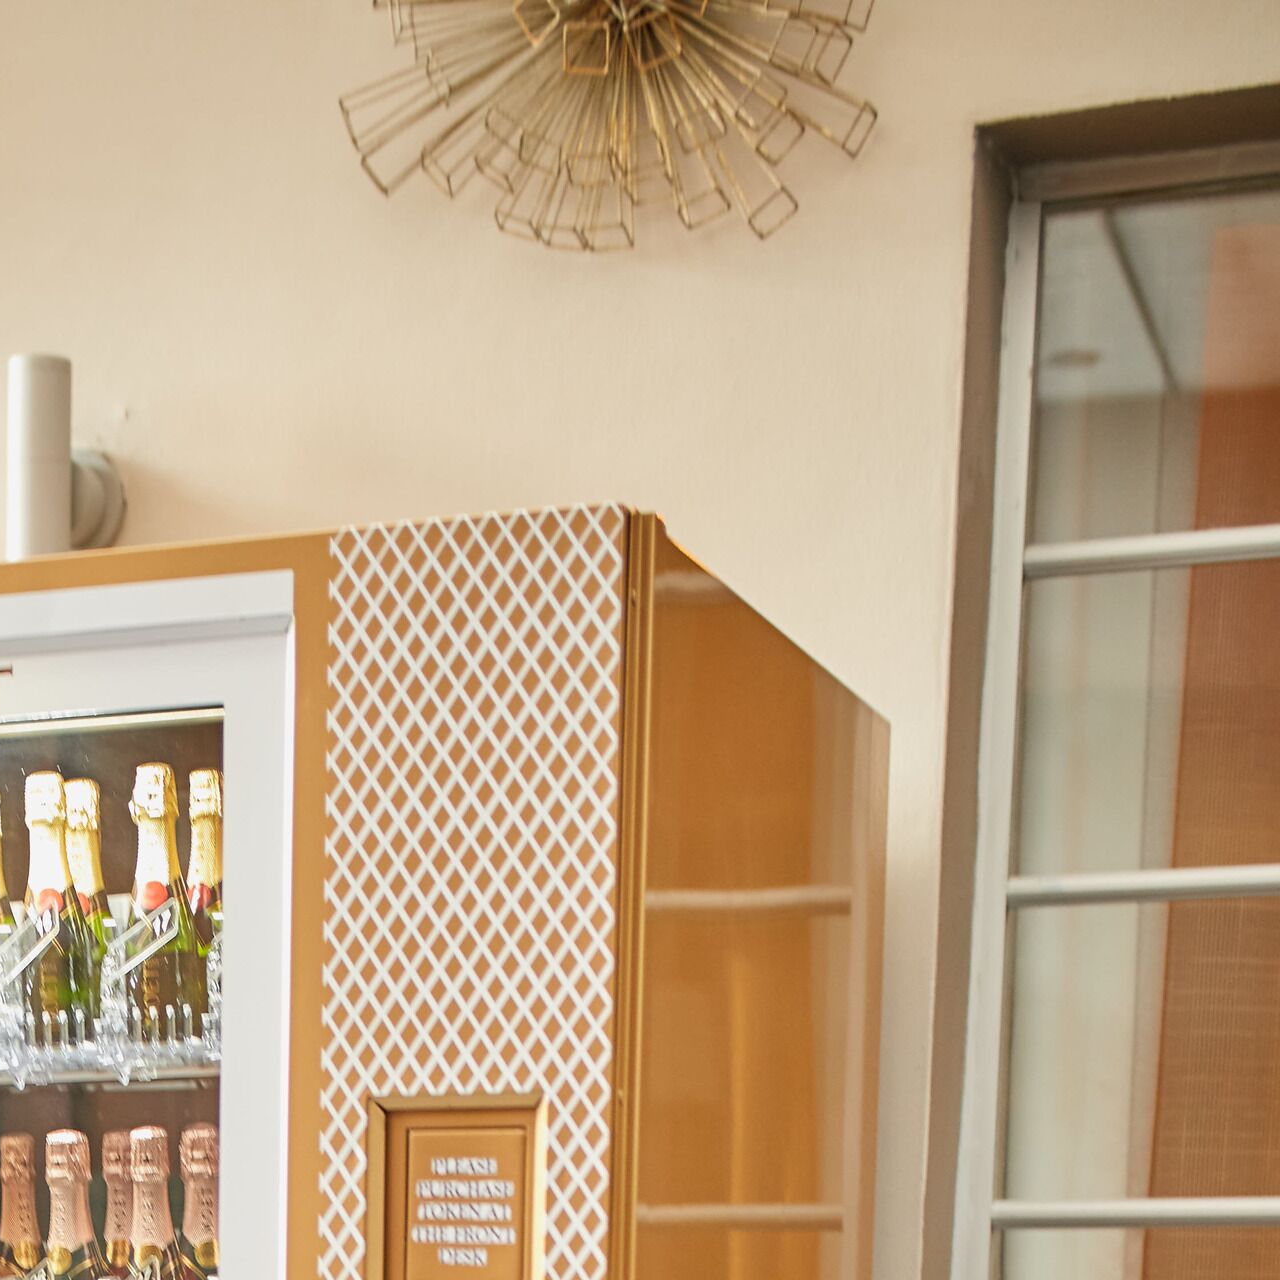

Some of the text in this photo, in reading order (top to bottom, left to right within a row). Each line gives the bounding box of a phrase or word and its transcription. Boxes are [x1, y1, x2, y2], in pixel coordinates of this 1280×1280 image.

[433, 1158, 497, 1175] PLEASE
[417, 1181, 515, 1198] PURCHASE
[419, 1203, 511, 1221] TOKEN AT
[413, 1226, 516, 1245] THE FRONT
[439, 1248, 487, 1266] DESK
